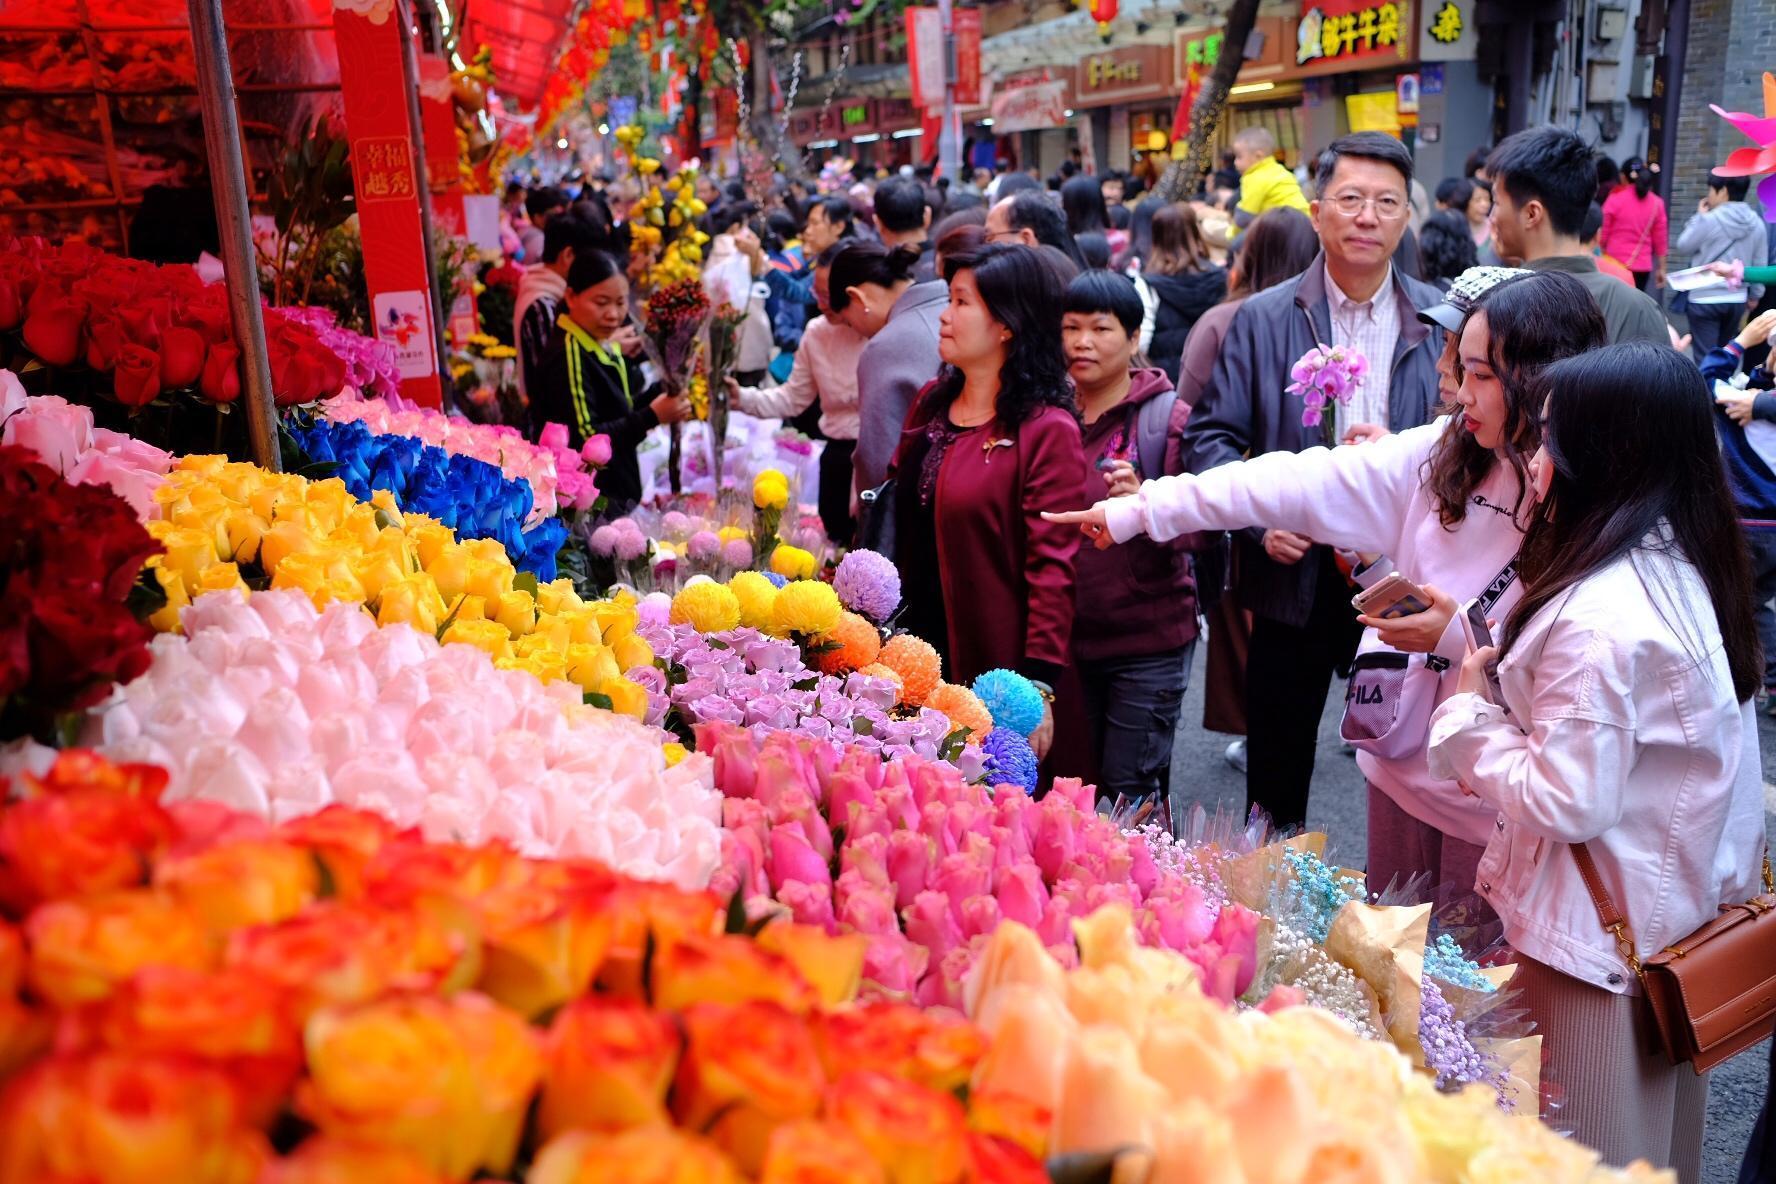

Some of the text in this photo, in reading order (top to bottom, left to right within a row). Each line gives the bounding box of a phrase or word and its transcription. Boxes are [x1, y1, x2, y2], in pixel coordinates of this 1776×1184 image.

[367, 143, 408, 169] 幸福
[365, 170, 410, 195] 越秀
[1489, 566, 1516, 593] FILA
[1345, 684, 1384, 705] FILA
